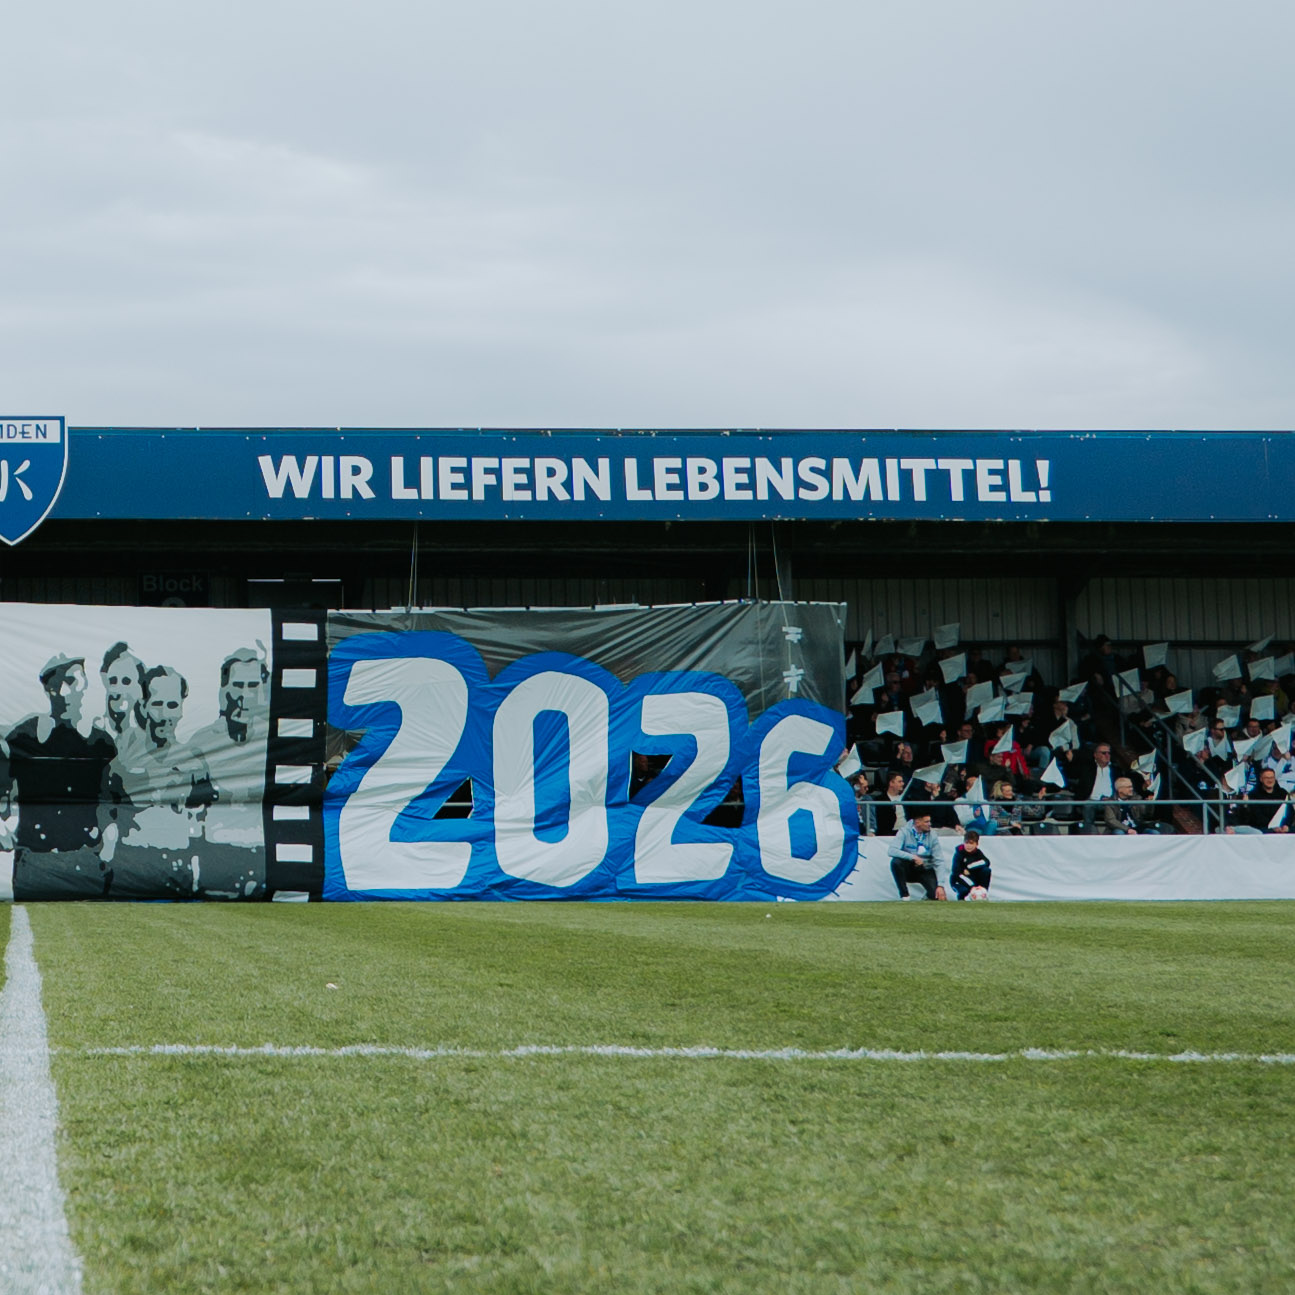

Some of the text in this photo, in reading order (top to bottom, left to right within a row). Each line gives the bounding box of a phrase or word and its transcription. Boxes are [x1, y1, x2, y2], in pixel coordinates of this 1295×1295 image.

[258, 455, 1051, 502] WIR LIEFERN LEBENSMITTEL!
[143, 575, 203, 592] Block
[338, 657, 846, 891] 2026
